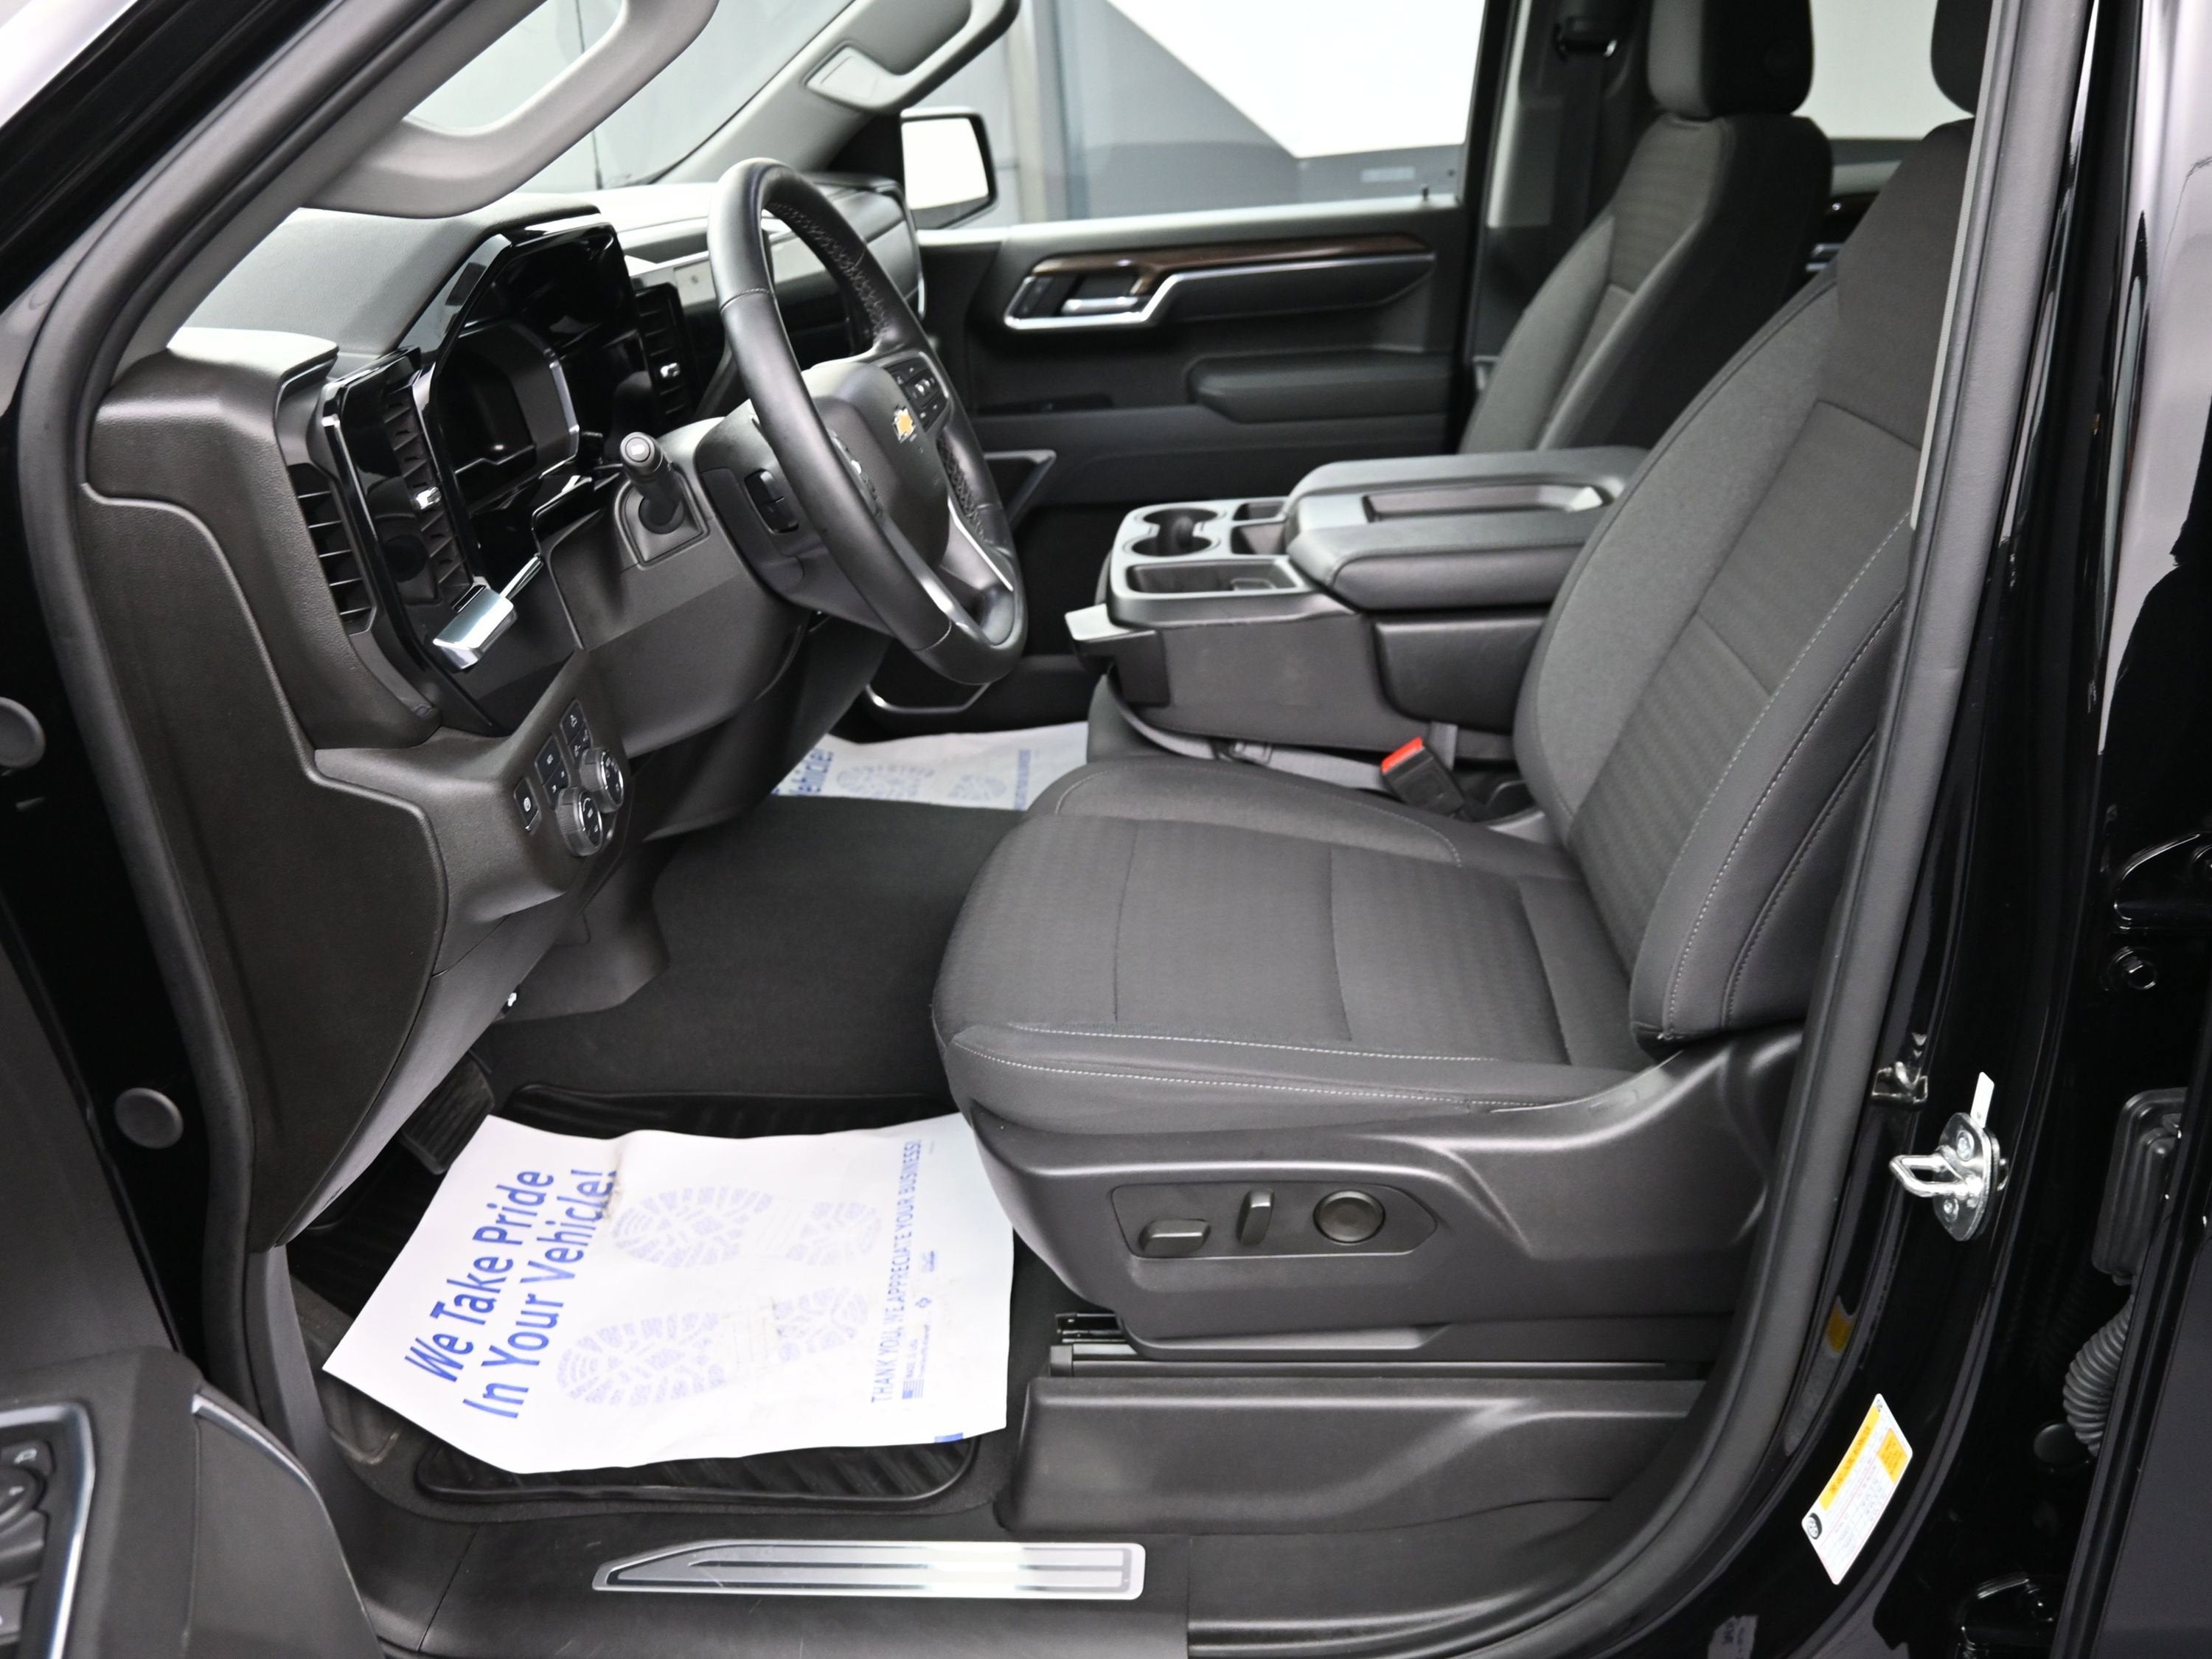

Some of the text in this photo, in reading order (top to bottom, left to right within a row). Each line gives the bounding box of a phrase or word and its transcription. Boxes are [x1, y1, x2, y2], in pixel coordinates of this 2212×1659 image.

[894, 1196, 915, 1232] YOUR
[405, 1170, 554, 1382] We Take Pride
[463, 1169, 617, 1419] In Your Vehicle!
[887, 1231, 912, 1302] APPRECIATE
[878, 1326, 903, 1357] YOU,
[871, 1358, 897, 1403] THANK
